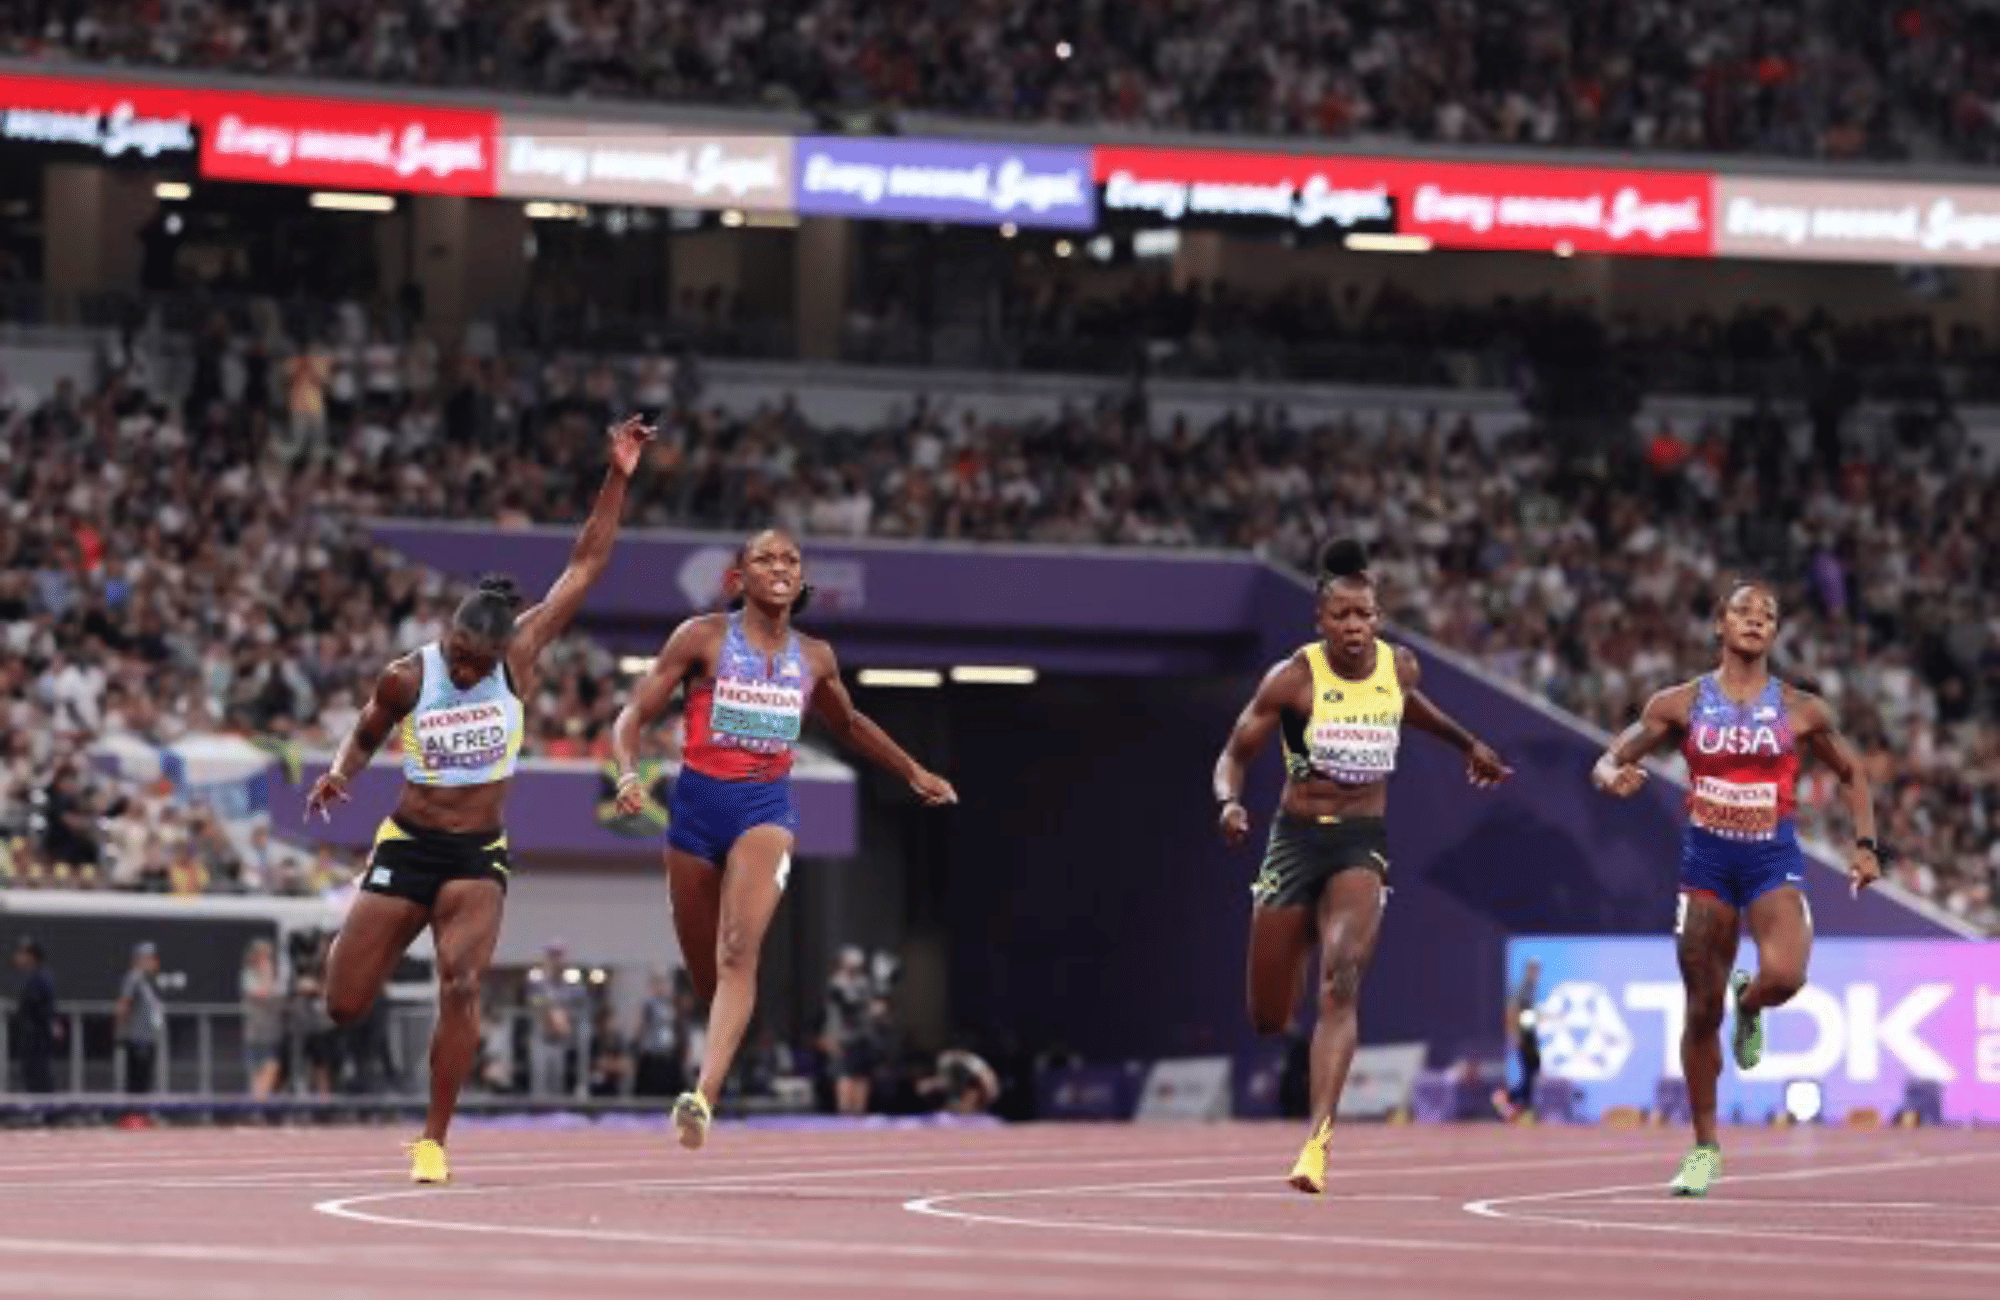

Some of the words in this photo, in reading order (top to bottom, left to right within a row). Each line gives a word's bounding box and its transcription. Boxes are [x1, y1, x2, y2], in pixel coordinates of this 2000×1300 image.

[718, 685, 800, 708] HONDA
[419, 705, 501, 729] HONDA
[425, 726, 505, 753] ALFRED
[1315, 729, 1394, 743] HONDA
[1696, 724, 1781, 755] USA
[1698, 778, 1773, 801] HONDA
[1623, 981, 1957, 1081] TDK
